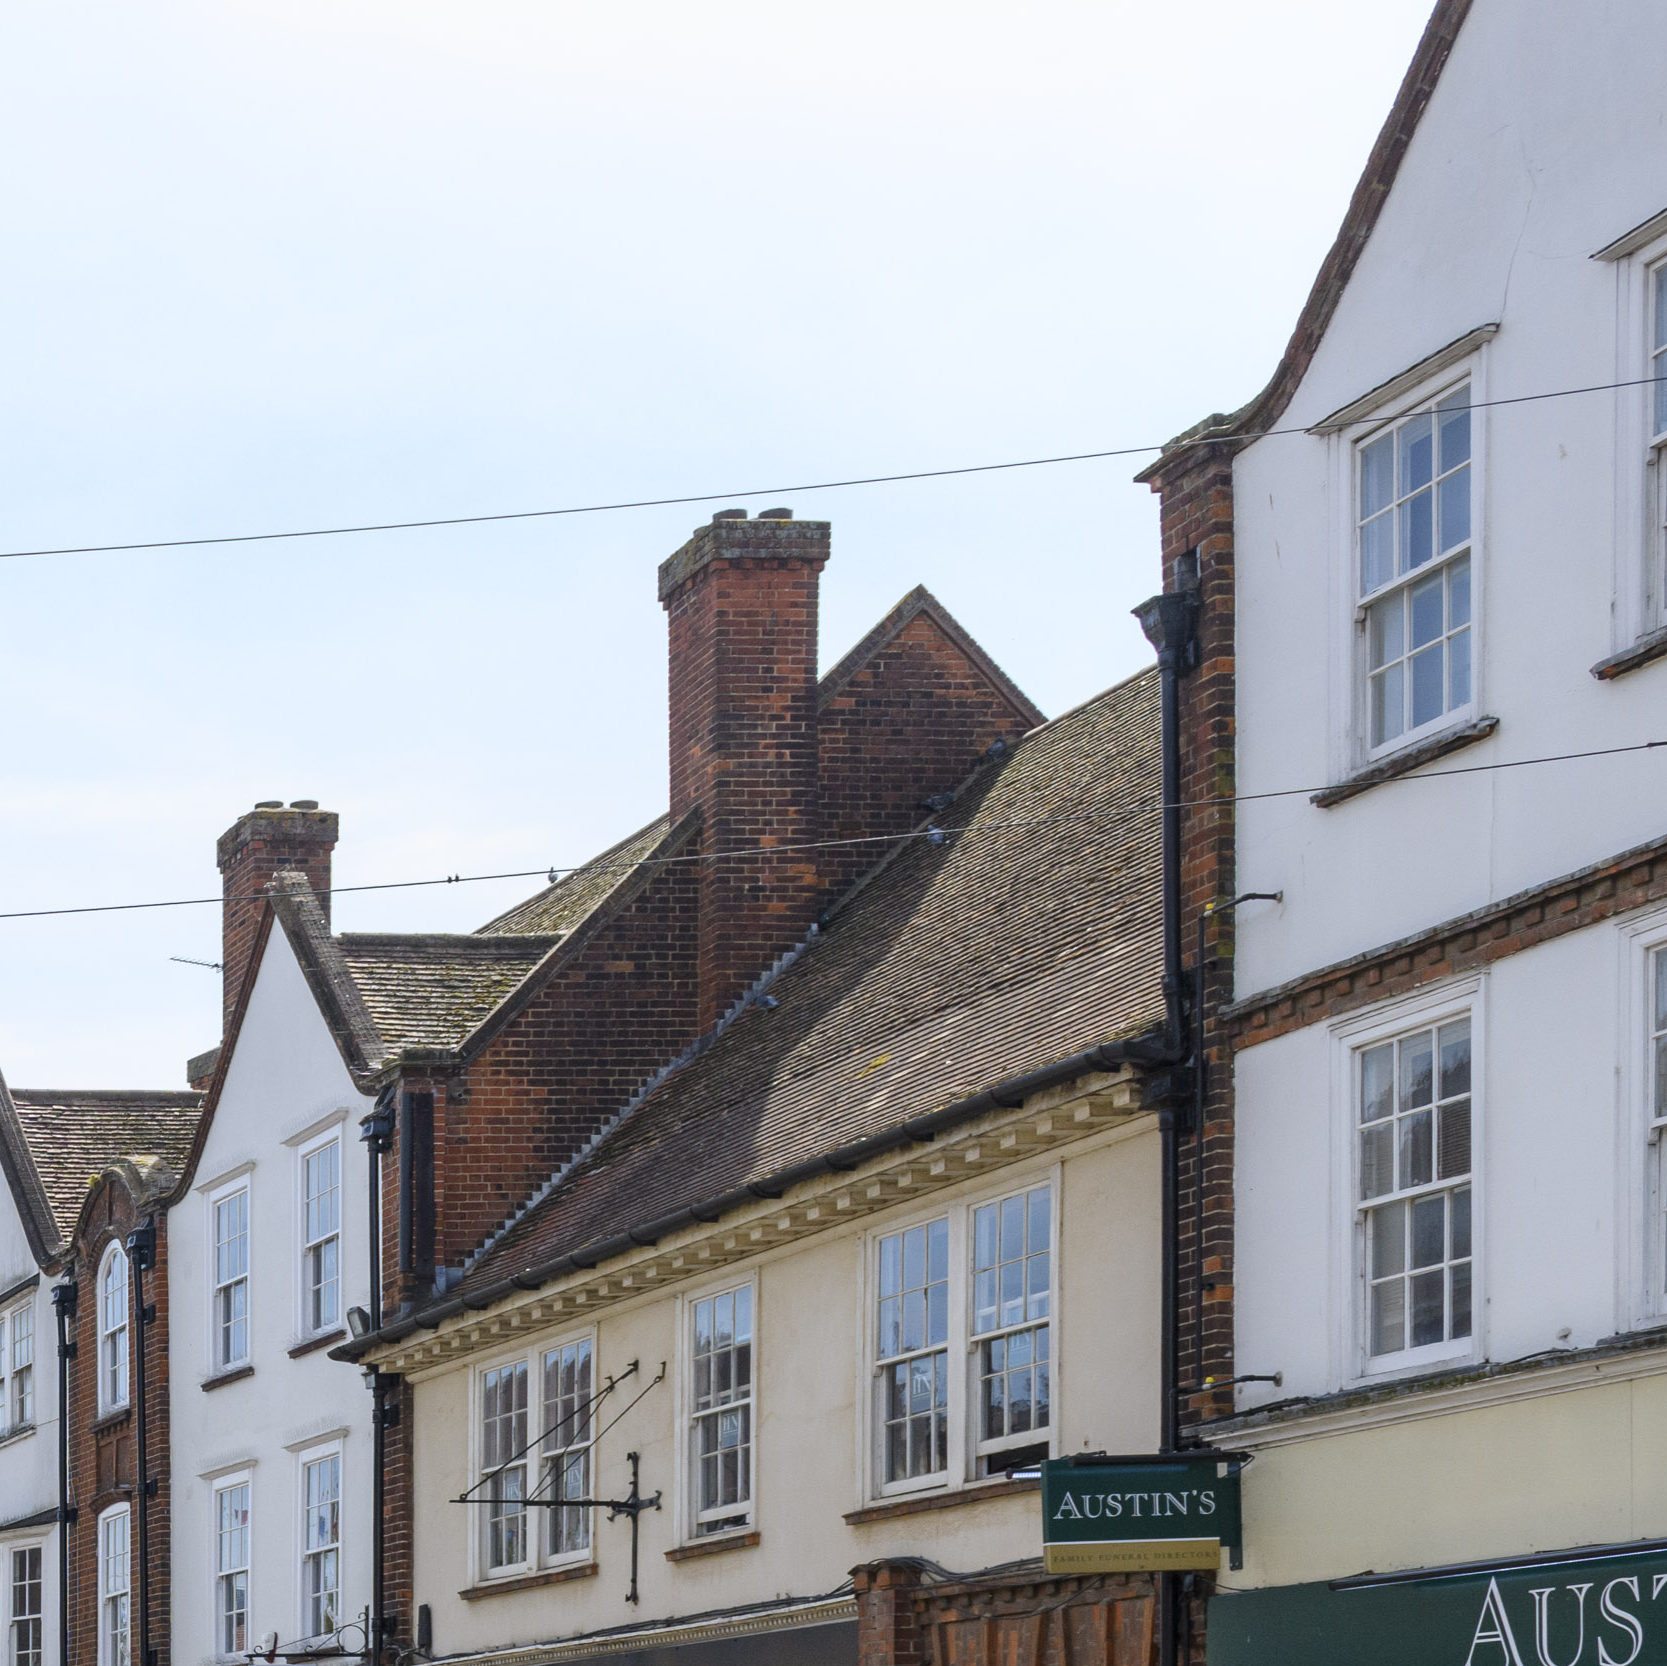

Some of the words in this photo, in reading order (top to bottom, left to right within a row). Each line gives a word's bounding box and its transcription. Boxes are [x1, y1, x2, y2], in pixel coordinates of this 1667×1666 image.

[1053, 1490, 1216, 1520] AUSTIN'S
[1053, 1554, 1093, 1563] FAMILY
[1099, 1553, 1148, 1562] FUNERAL
[1154, 1551, 1219, 1560] DIRECTORS
